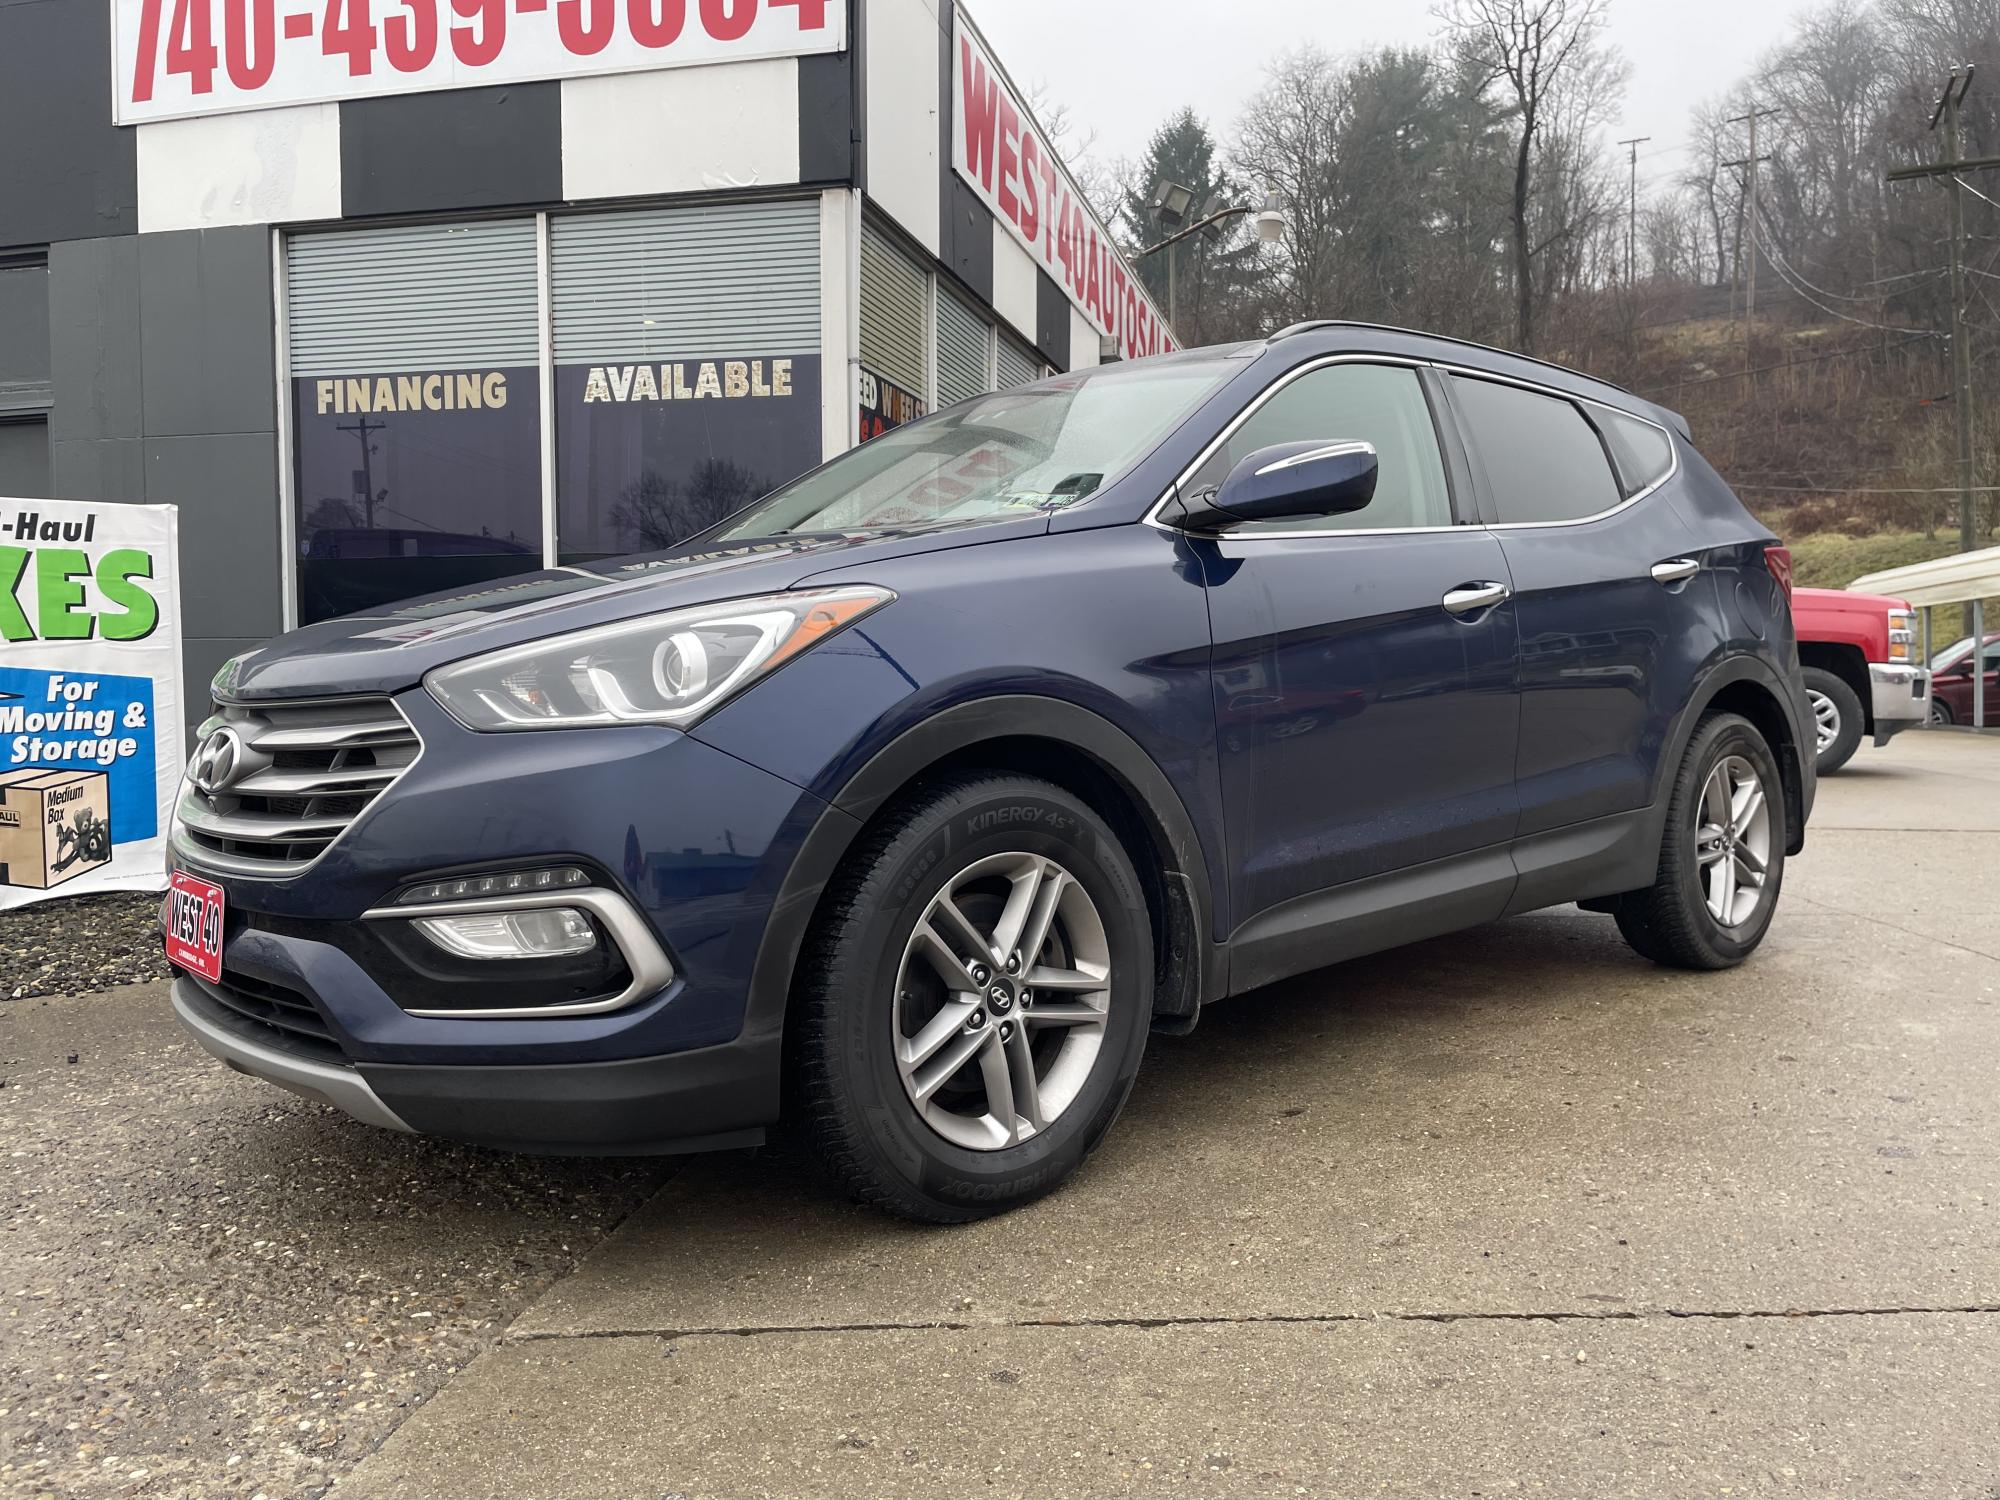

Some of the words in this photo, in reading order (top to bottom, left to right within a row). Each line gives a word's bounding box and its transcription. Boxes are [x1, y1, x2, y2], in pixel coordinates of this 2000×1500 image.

[317, 372, 507, 414] FINANCING
[583, 359, 793, 403] AVAILABLE
[0, 511, 96, 542] -Haul
[47, 675, 99, 702] For
[0, 703, 115, 737] Moving
[122, 701, 147, 728] &
[11, 735, 138, 765] Storage
[47, 785, 84, 808] Medium
[47, 807, 65, 825] Box
[170, 887, 204, 949] WEST
[202, 900, 220, 957] 40
